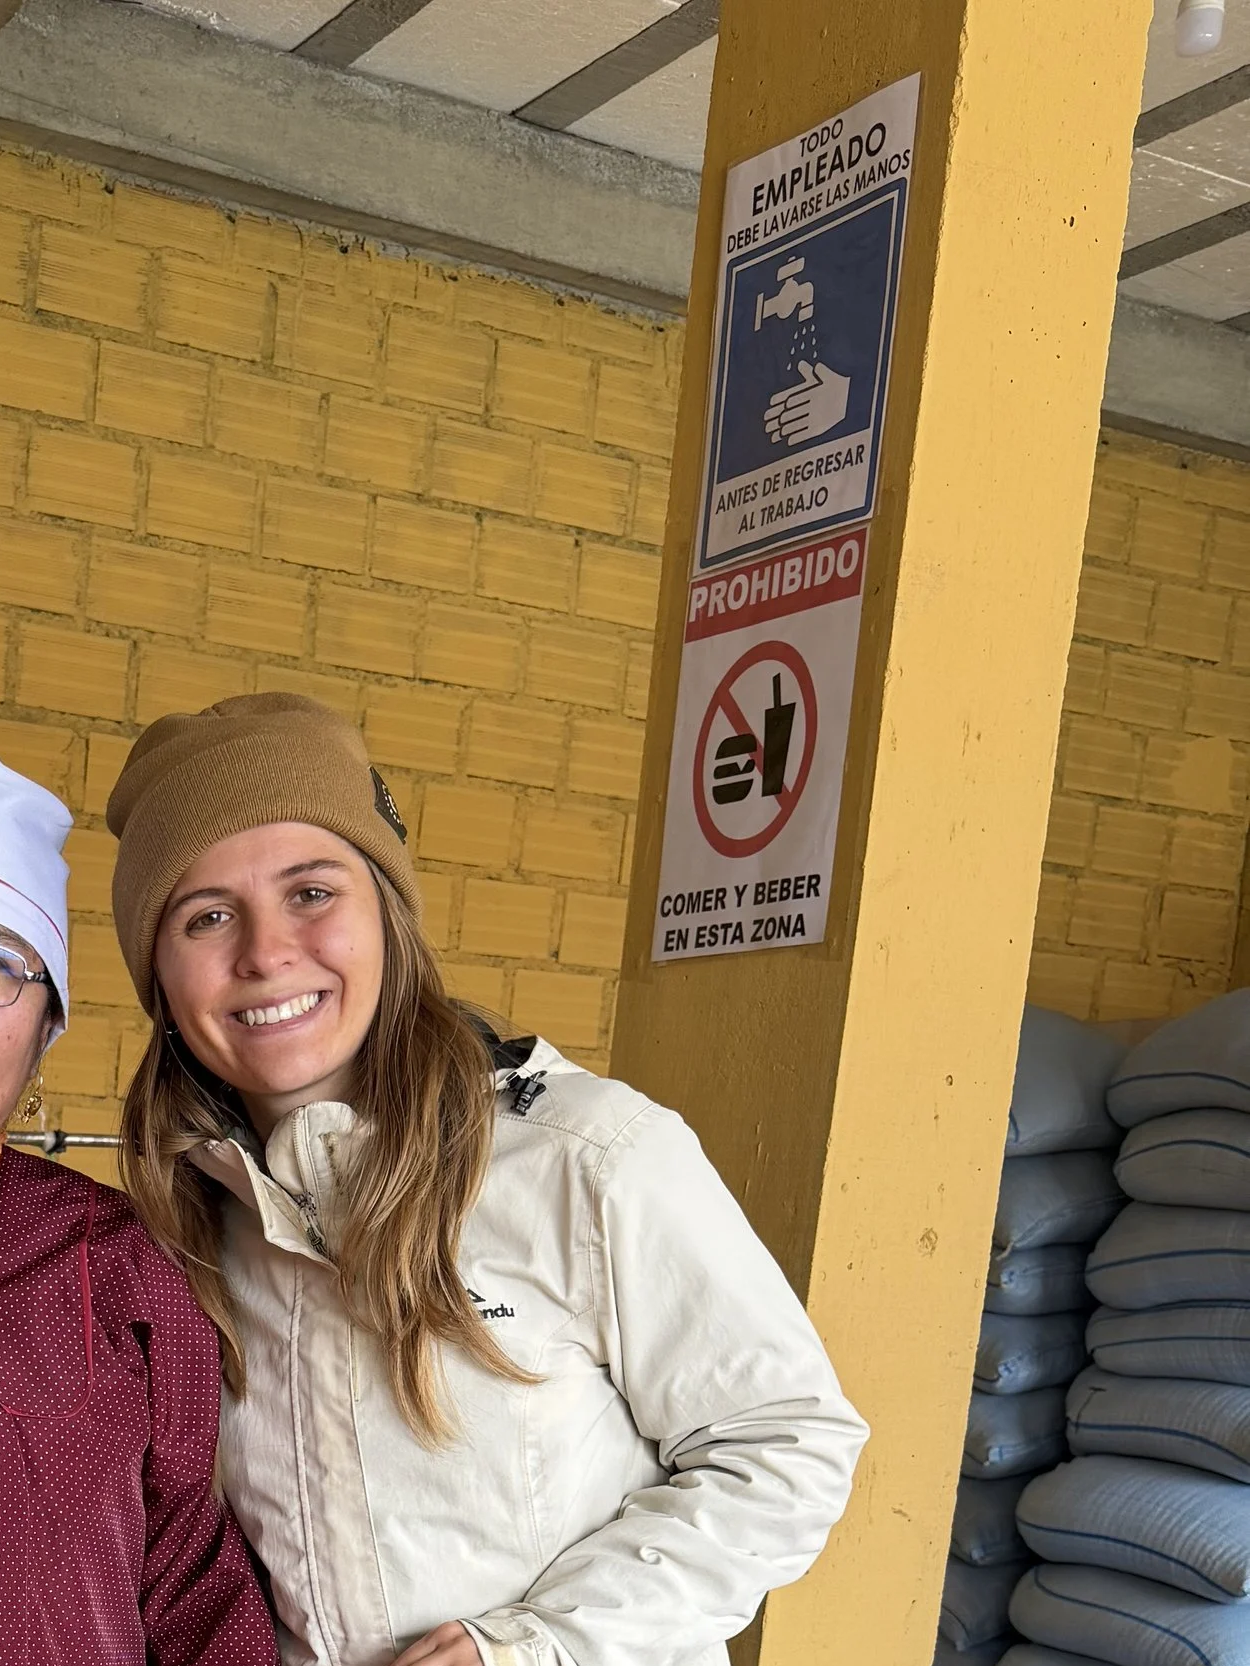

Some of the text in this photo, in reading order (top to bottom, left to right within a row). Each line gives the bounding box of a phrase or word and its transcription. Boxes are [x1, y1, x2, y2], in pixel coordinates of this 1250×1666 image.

[799, 119, 843, 158] TODO
[752, 122, 886, 216] EMPLEADO
[727, 149, 911, 254] DEBE LAVARSE LAS MANOS
[715, 444, 865, 514] ANTES DE REGRESAR
[738, 486, 828, 535] AL TRABAJO
[688, 539, 860, 623] PROHIBIDO
[660, 874, 821, 918] COMER Y BEBER
[664, 913, 806, 952] EN ESTA ZONA
